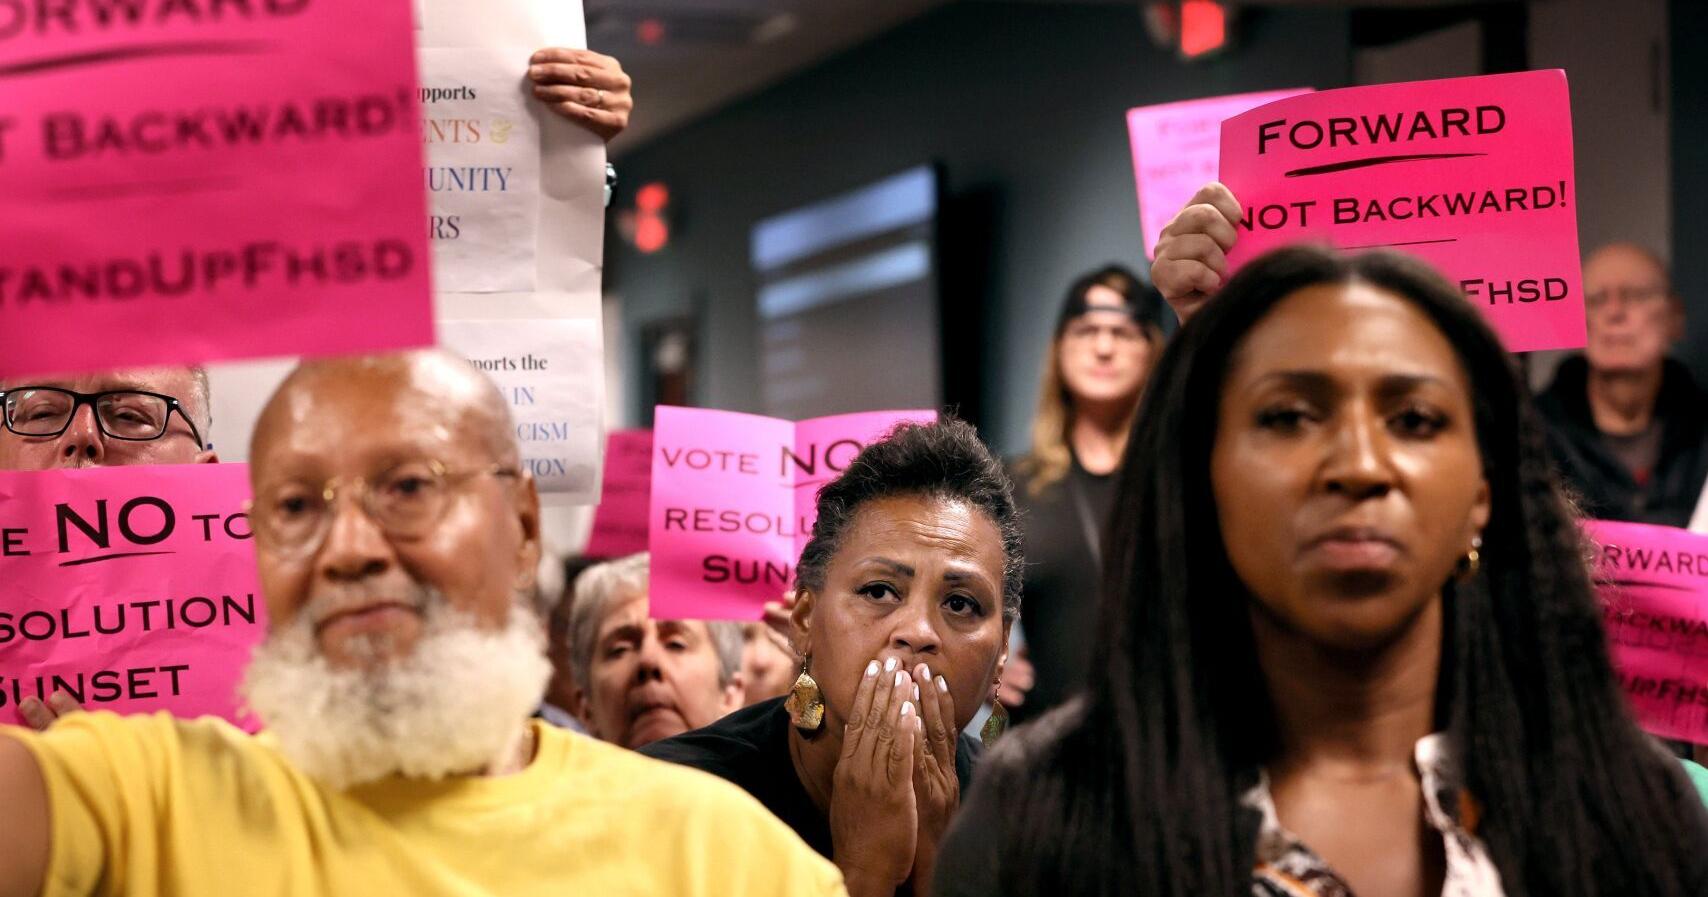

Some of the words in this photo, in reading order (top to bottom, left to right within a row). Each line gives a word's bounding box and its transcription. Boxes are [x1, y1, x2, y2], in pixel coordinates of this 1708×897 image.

[417, 85, 477, 103] pports
[422, 119, 480, 144] NTS
[489, 117, 513, 144] &
[1258, 105, 1506, 154] FORWARD
[422, 167, 513, 192] UNITY
[1333, 180, 1567, 225] BACKWARD!
[521, 354, 549, 371] the
[513, 386, 535, 405] IN
[522, 457, 567, 477] ION
[661, 447, 760, 475] VOTE
[776, 439, 866, 476] NO
[54, 495, 176, 554] NO
[191, 512, 255, 543] TO
[703, 554, 789, 585] SUN
[0, 664, 190, 709] UNSET
